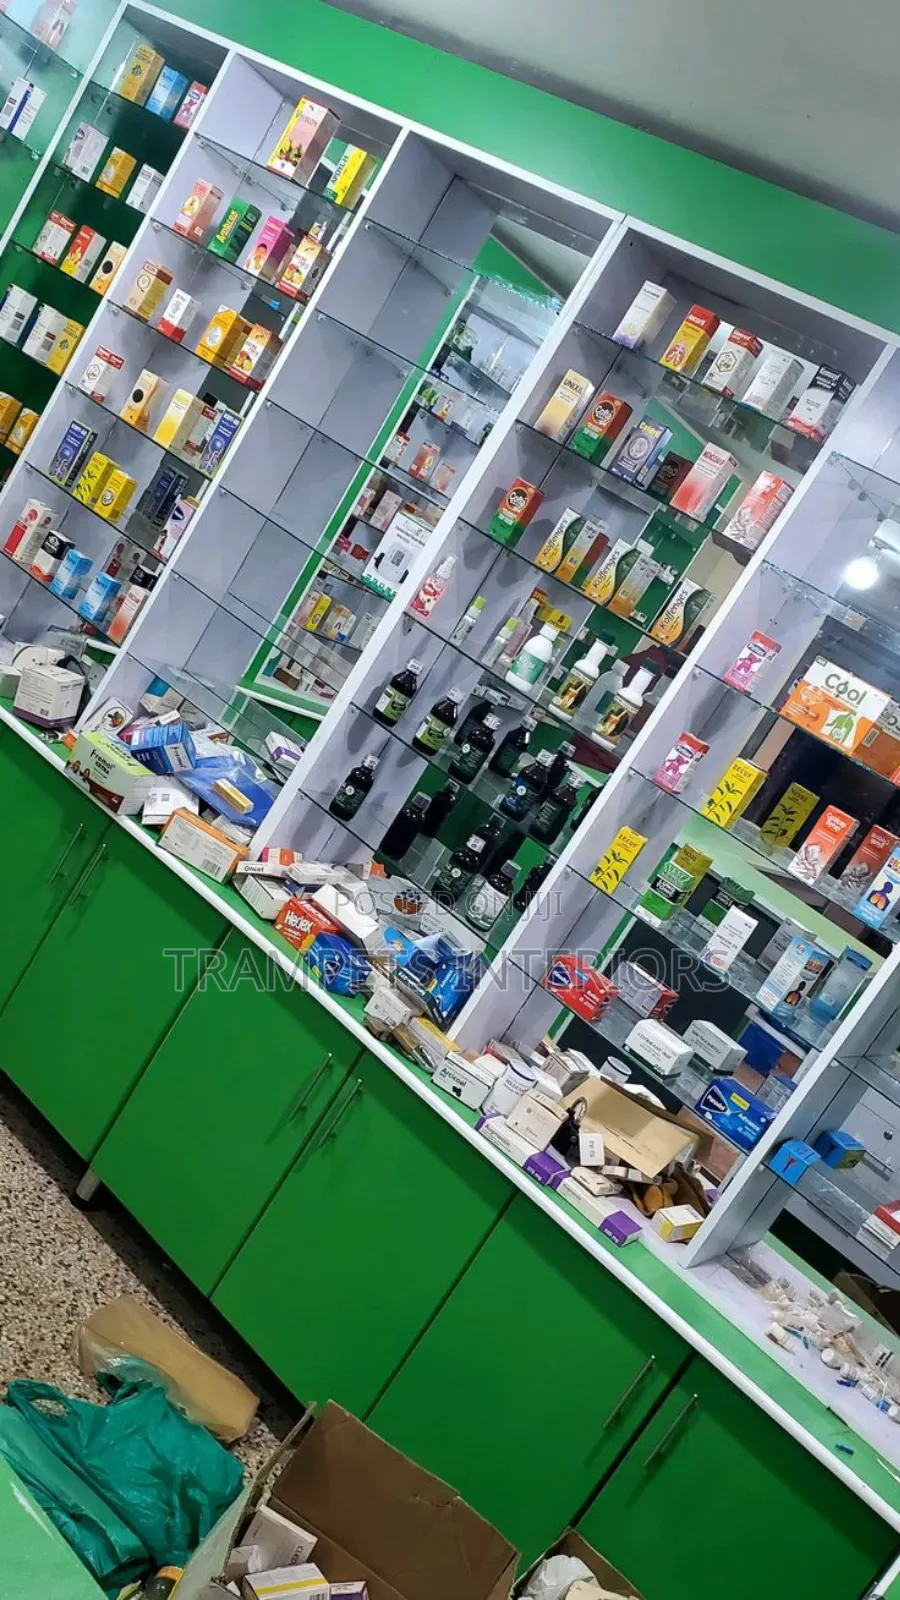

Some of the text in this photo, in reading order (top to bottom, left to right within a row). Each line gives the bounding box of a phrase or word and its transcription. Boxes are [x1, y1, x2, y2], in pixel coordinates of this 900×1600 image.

[217, 210, 239, 244] Ambrox
[542, 519, 568, 557] Koffenges
[593, 550, 620, 589] Koffenges
[660, 590, 688, 630] Koffenges
[732, 764, 753, 779] ZECUF
[618, 834, 638, 848] ZECUF
[655, 884, 675, 898] TONIC
[285, 910, 314, 932] Hedex
[738, 1113, 761, 1132] Advance
